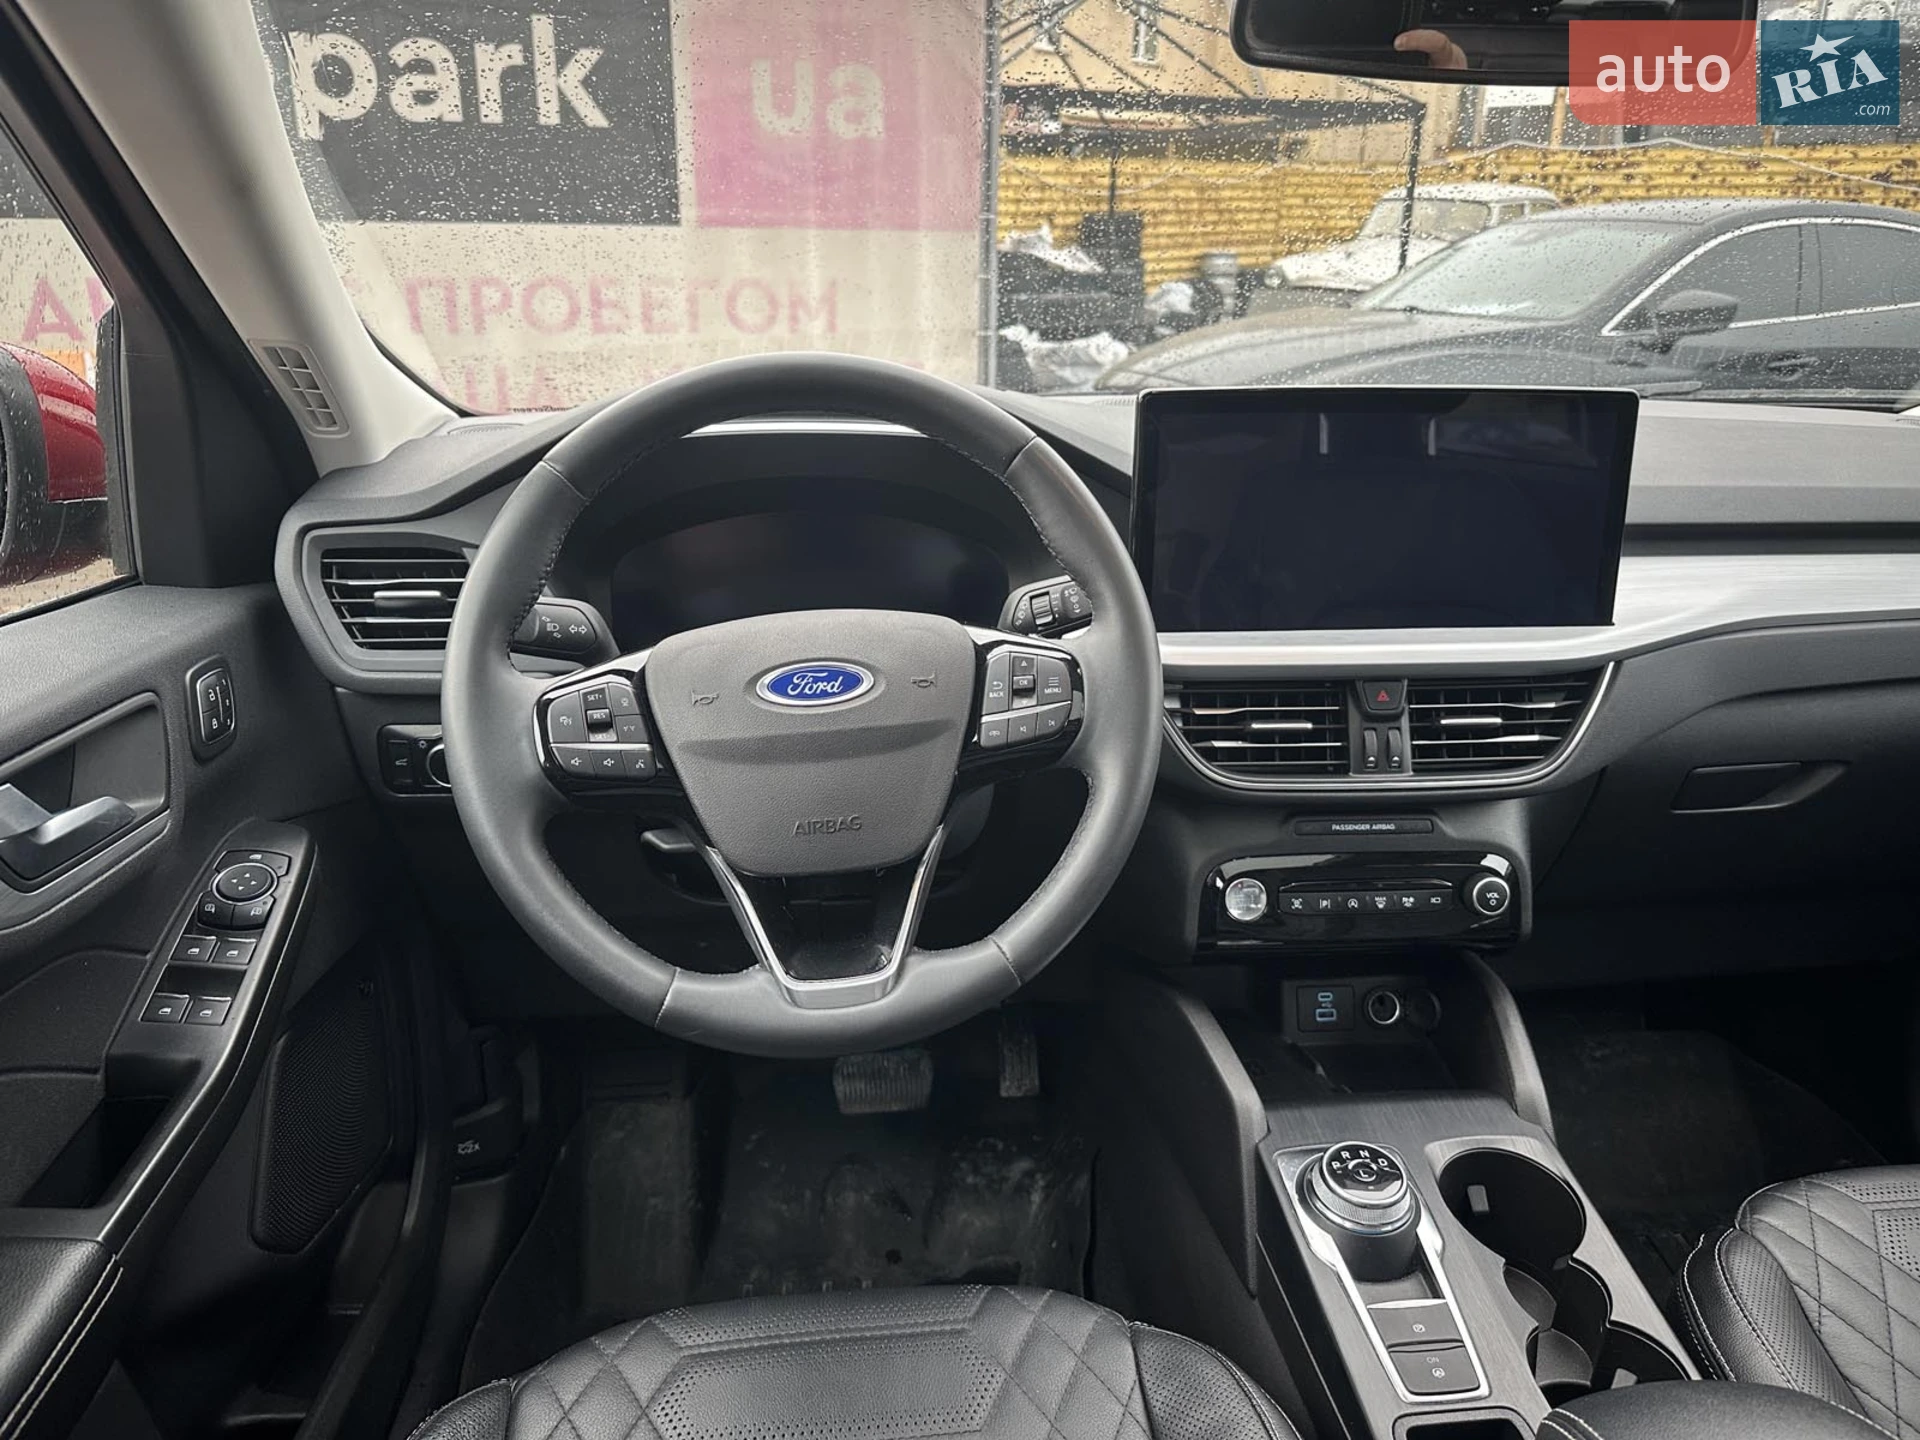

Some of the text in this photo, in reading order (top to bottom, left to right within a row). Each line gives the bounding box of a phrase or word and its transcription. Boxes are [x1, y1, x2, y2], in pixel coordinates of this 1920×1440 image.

[286, 14, 611, 141] park
[752, 58, 886, 140] ua
[404, 275, 840, 336] ПРОБЕГОМ
[787, 671, 844, 696] Ford
[1044, 687, 1062, 695] MENU
[988, 691, 1004, 699] BACK
[793, 815, 862, 836] AIRBAG
[1331, 822, 1396, 831] PASSENGER AIRBAG
[1340, 1151, 1351, 1159] R
[1359, 1150, 1370, 1158] N
[1378, 1158, 1388, 1166] D
[1359, 1169, 1369, 1178] L
